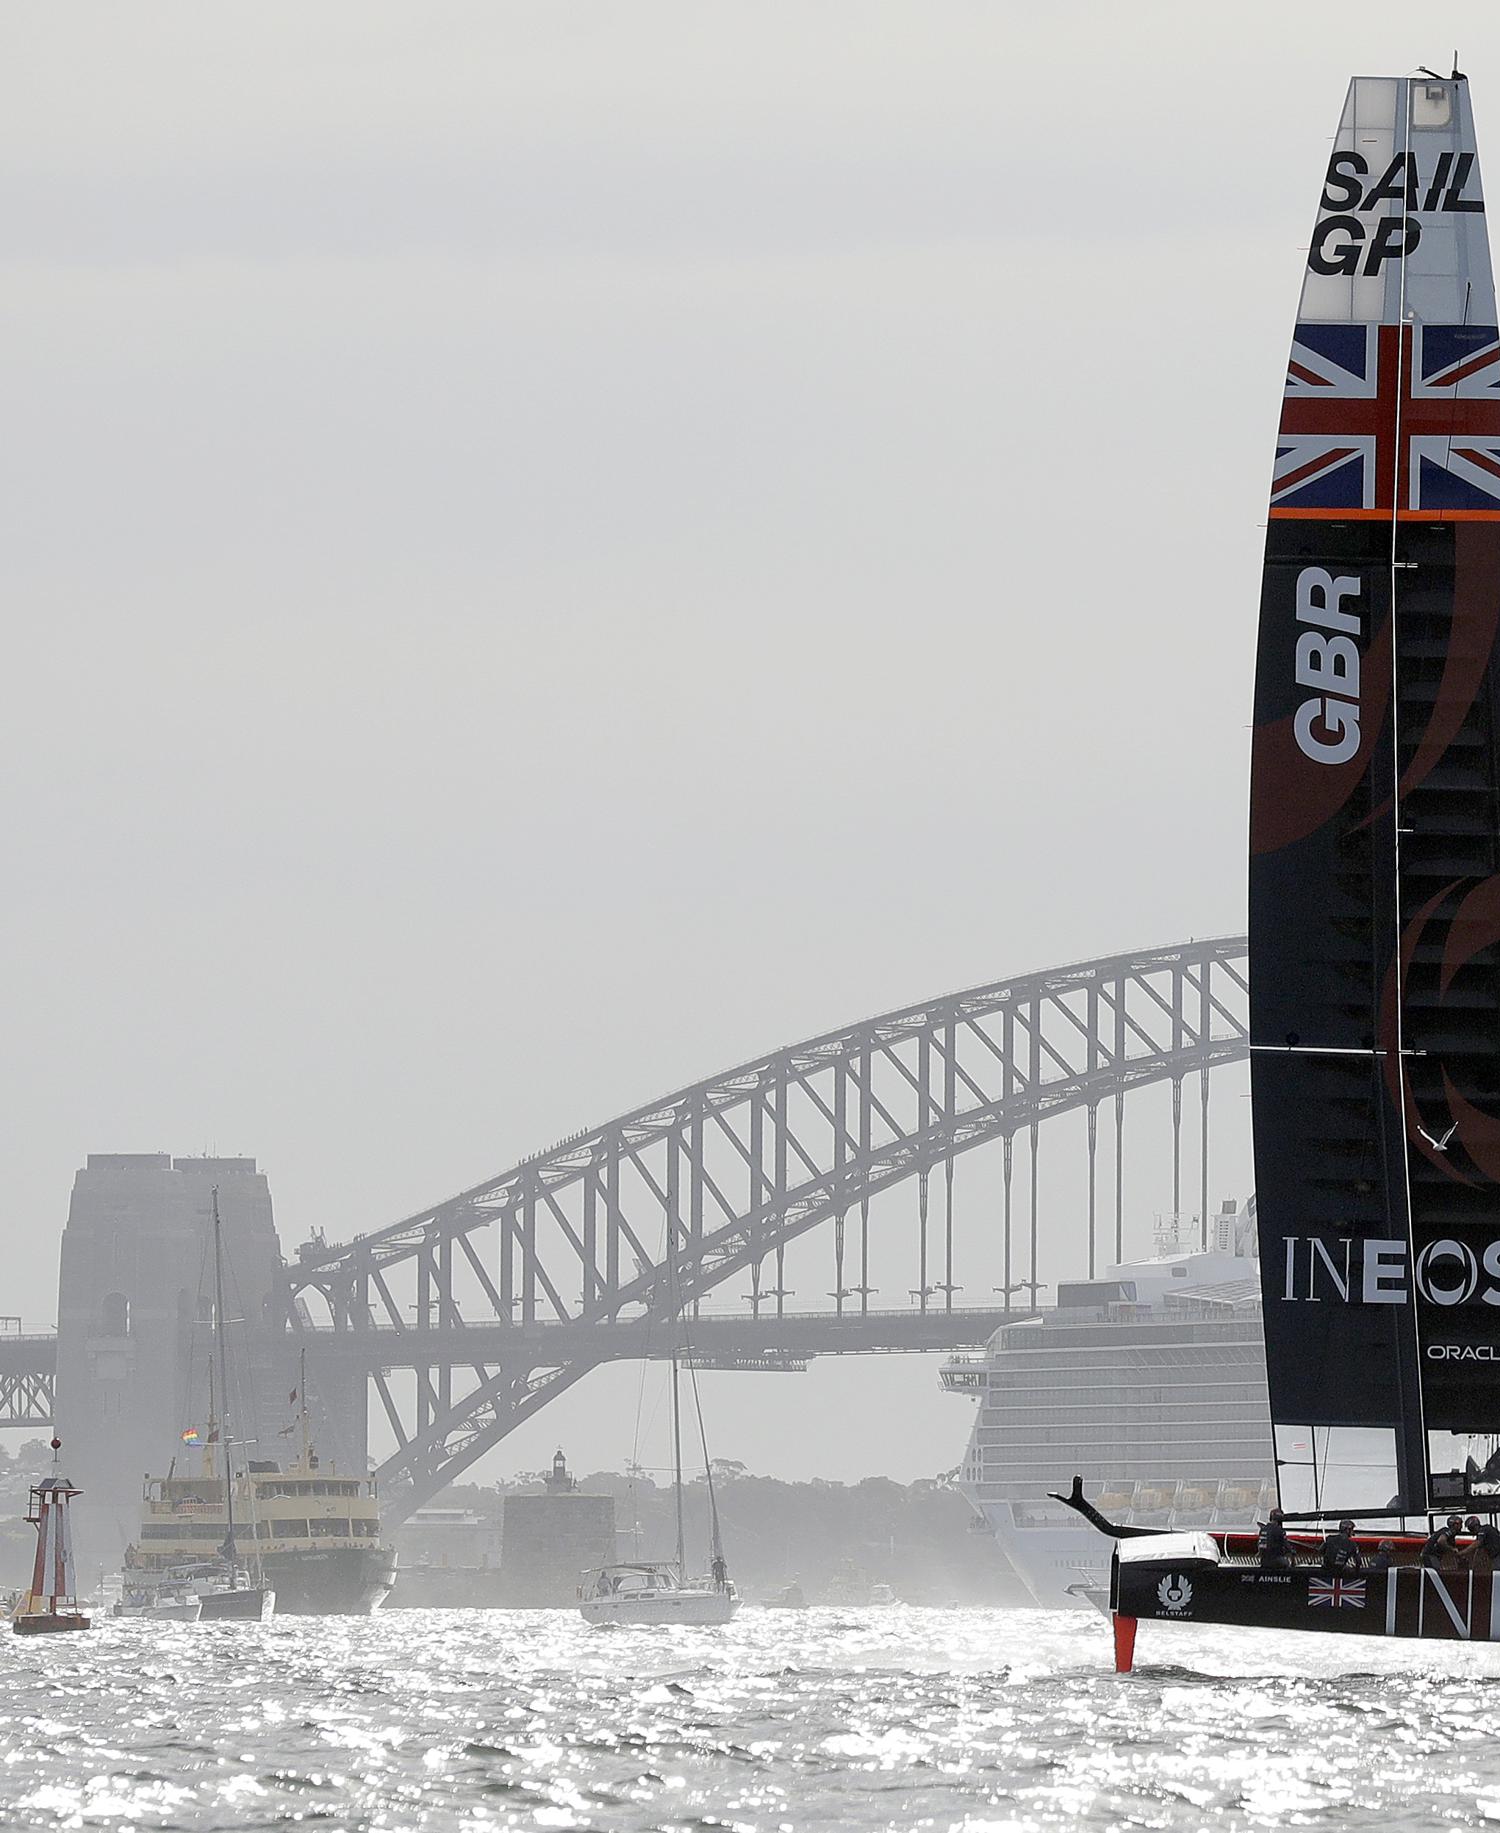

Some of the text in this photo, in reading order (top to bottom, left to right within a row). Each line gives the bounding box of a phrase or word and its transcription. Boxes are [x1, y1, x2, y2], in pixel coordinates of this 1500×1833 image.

[1320, 151, 1485, 212] SAIL
[1308, 215, 1422, 276] GP
[1293, 566, 1361, 765] GBR
[1258, 1575, 1292, 1583] AINSLIE
[1155, 1609, 1193, 1617] BELSTAFF
